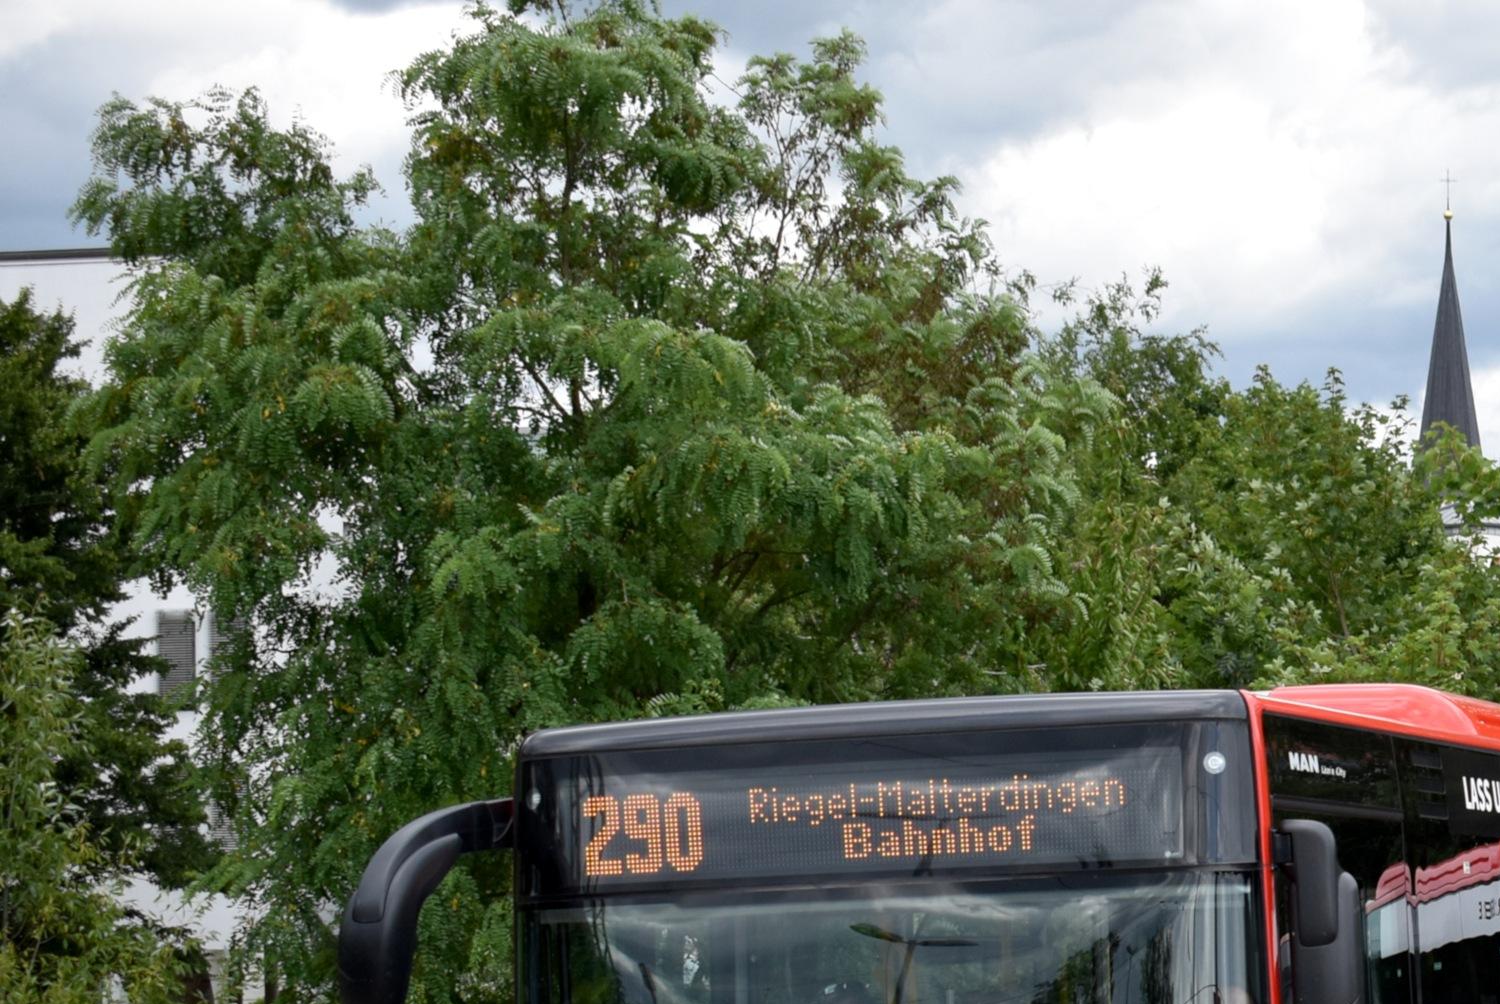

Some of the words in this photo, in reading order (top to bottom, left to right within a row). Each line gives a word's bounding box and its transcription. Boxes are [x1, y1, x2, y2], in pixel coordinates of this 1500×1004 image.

[1288, 751, 1320, 773] MAN
[749, 774, 1126, 826] Riegel-Malterdingen
[1462, 776, 1493, 812] LASS
[583, 792, 703, 876] 290
[843, 814, 1035, 859] Bahnhof
